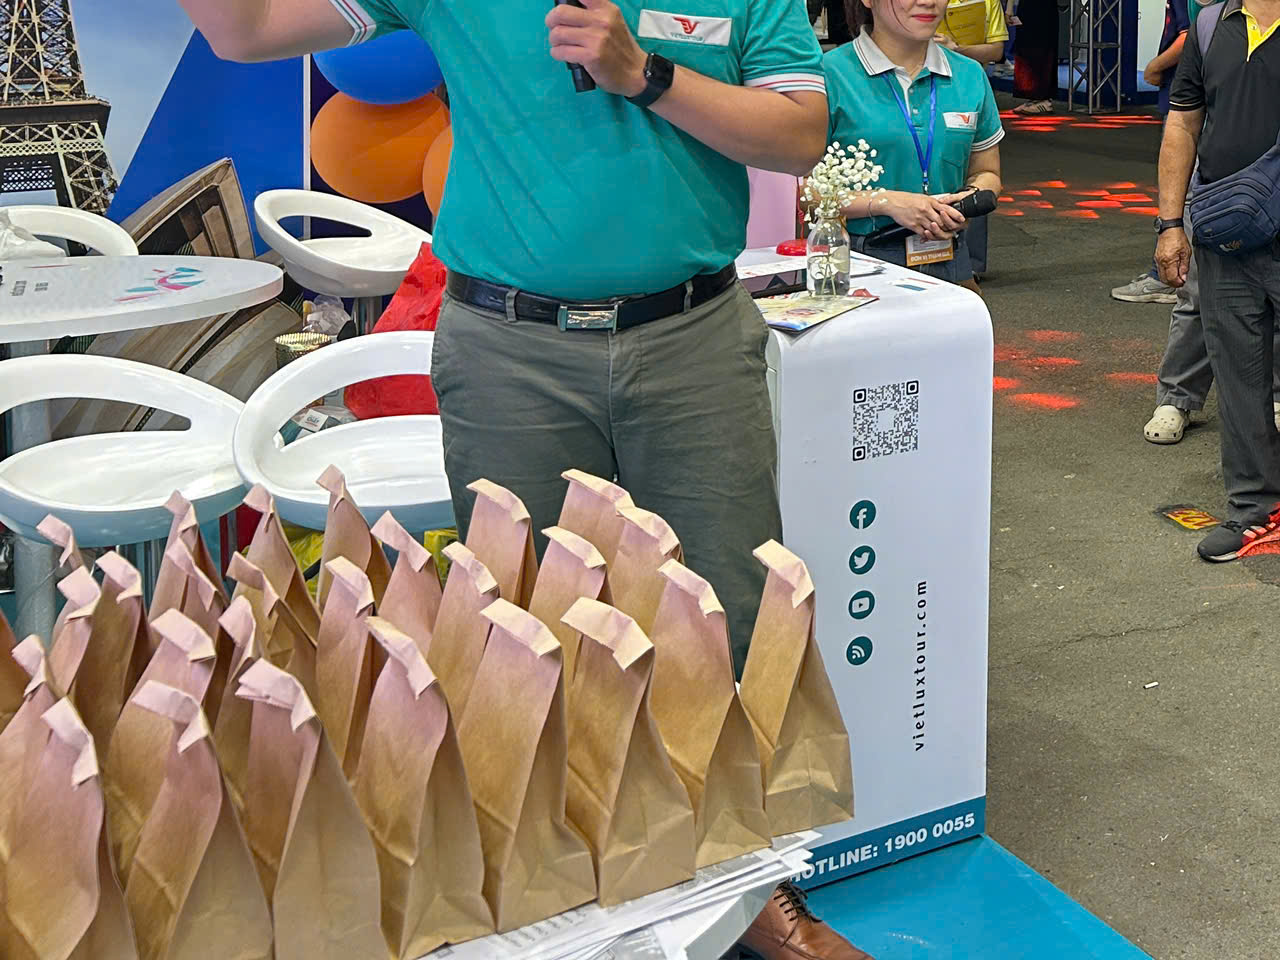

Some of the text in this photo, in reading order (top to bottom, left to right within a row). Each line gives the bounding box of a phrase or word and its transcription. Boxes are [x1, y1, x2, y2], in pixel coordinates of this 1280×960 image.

[912, 580, 928, 752] vietluxtour.com
[884, 828, 928, 853] 1900
[932, 812, 975, 837] 0055
